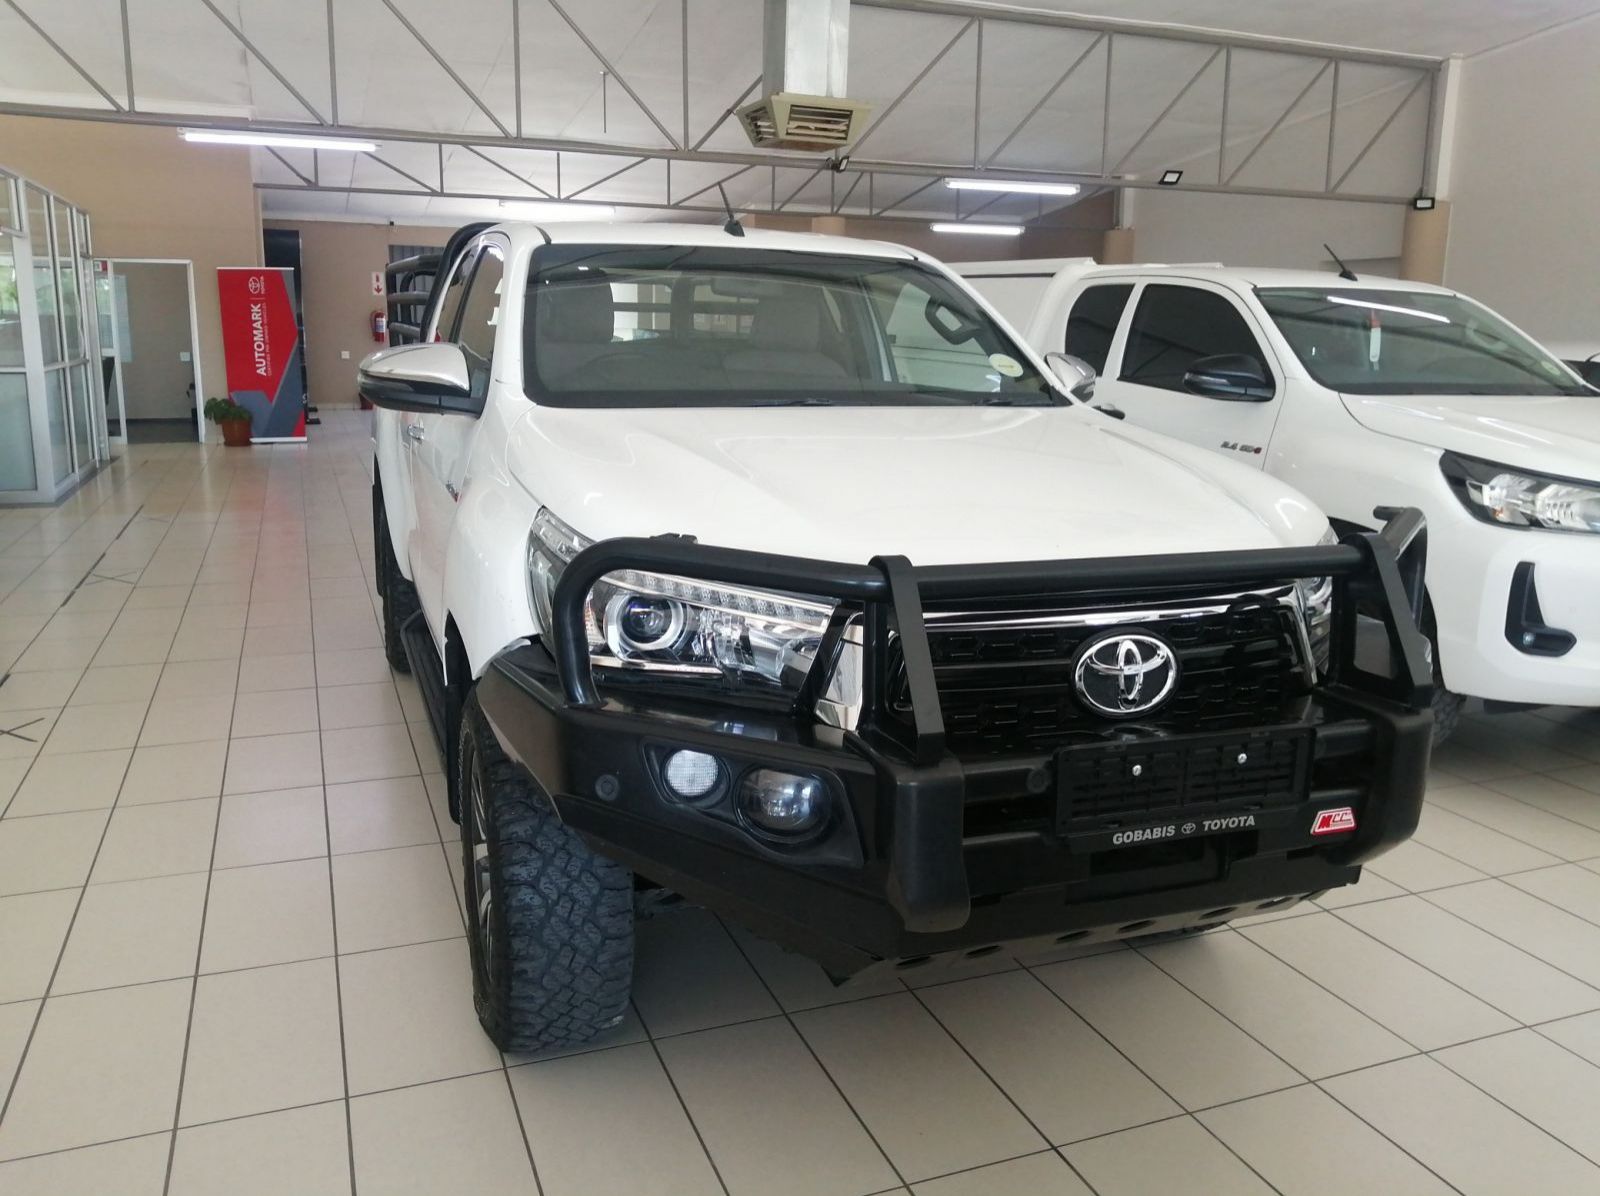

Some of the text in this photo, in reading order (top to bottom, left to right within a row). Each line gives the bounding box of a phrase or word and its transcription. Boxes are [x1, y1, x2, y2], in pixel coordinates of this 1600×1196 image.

[251, 303, 266, 376] AUTOMARK
[1112, 815, 1256, 845] GOBABIS TOYOTA
